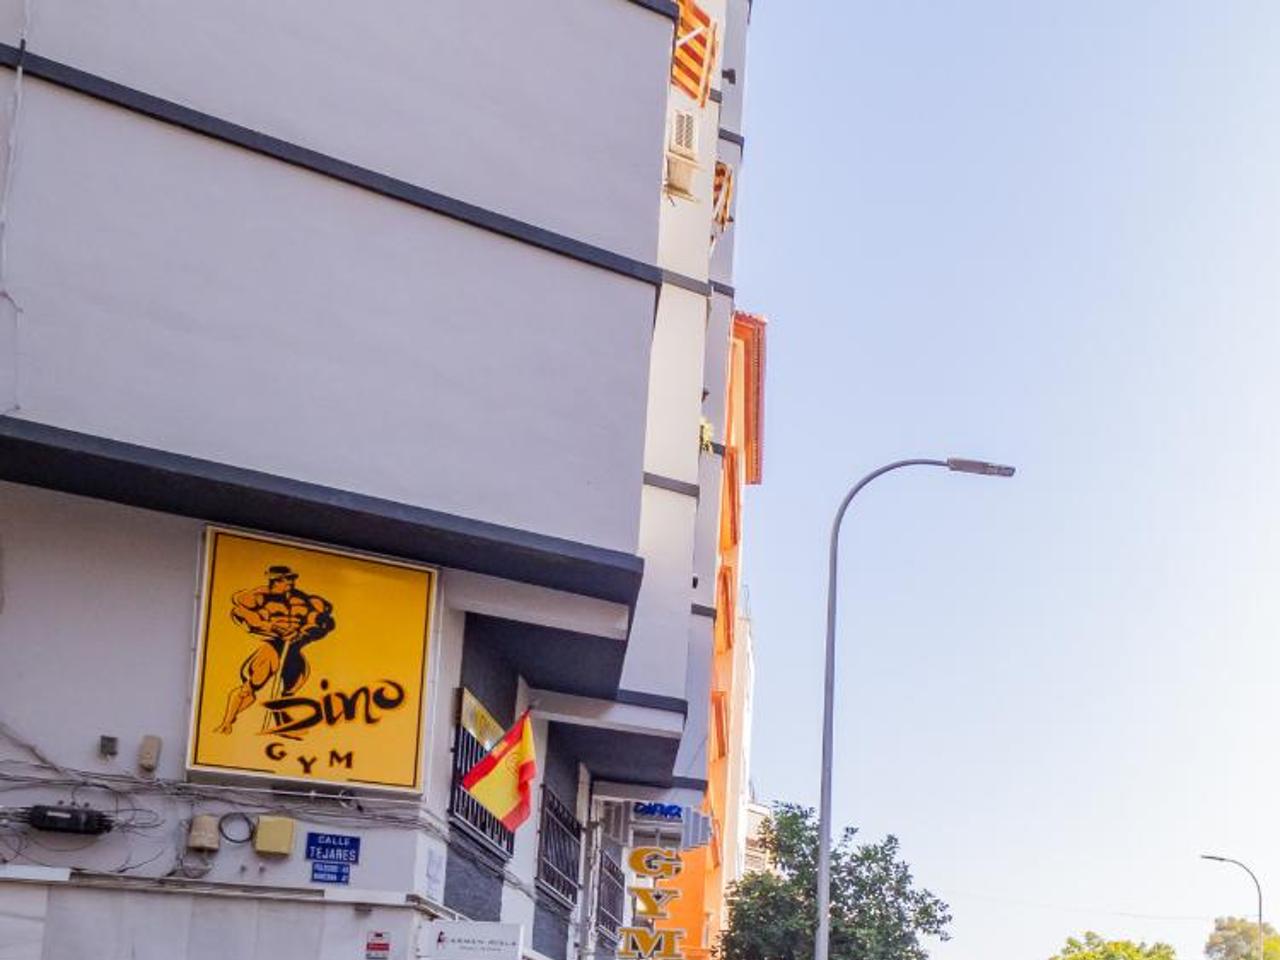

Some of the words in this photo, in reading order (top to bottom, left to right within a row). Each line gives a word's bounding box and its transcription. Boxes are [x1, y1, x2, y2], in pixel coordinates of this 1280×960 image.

[264, 678, 405, 735] Dino
[265, 742, 354, 774] GYM
[318, 835, 351, 847] CALLE
[309, 845, 357, 862] TEJARES
